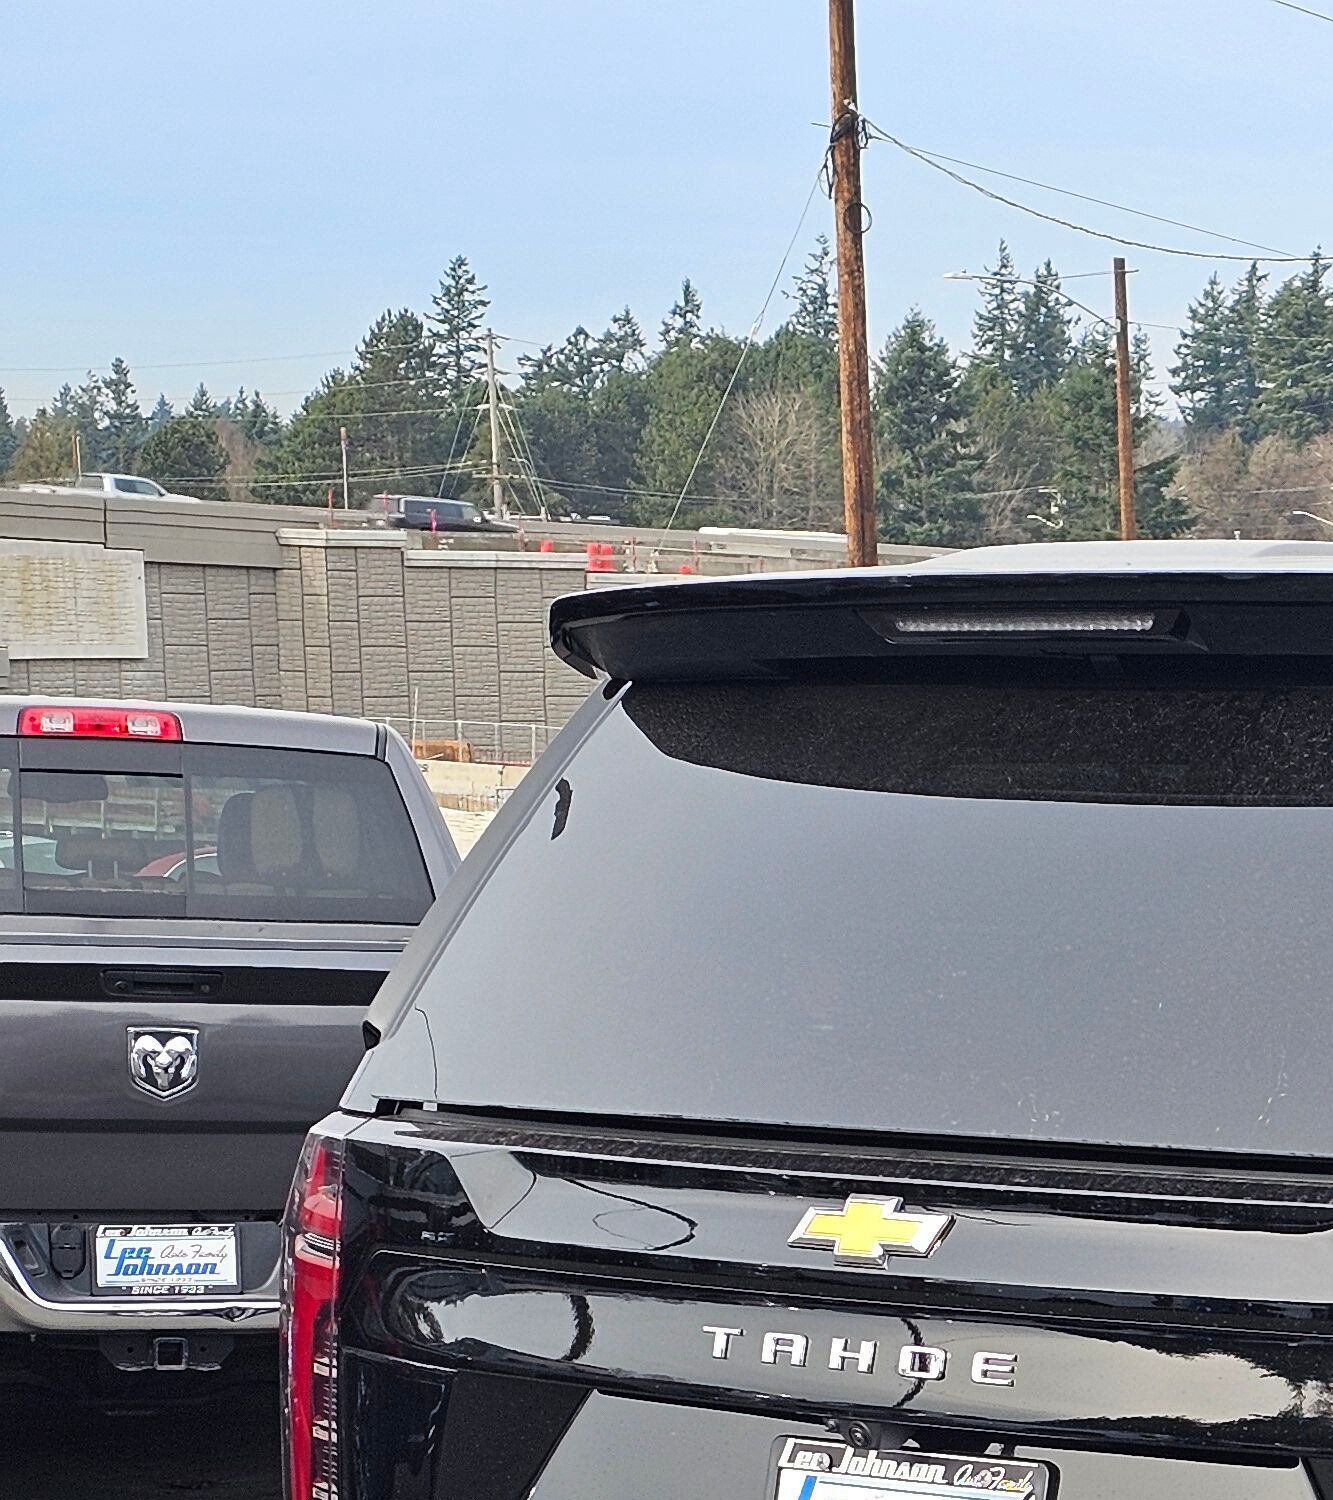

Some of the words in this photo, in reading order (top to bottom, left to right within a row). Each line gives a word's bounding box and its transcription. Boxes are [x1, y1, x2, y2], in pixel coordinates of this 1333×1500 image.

[104, 1239, 155, 1260] Lee
[106, 1254, 220, 1276] Johnson
[131, 1285, 170, 1294] SINCE
[174, 1285, 205, 1294] 1933
[702, 1325, 1018, 1387] TAHOE
[832, 1445, 948, 1484] Johnson
